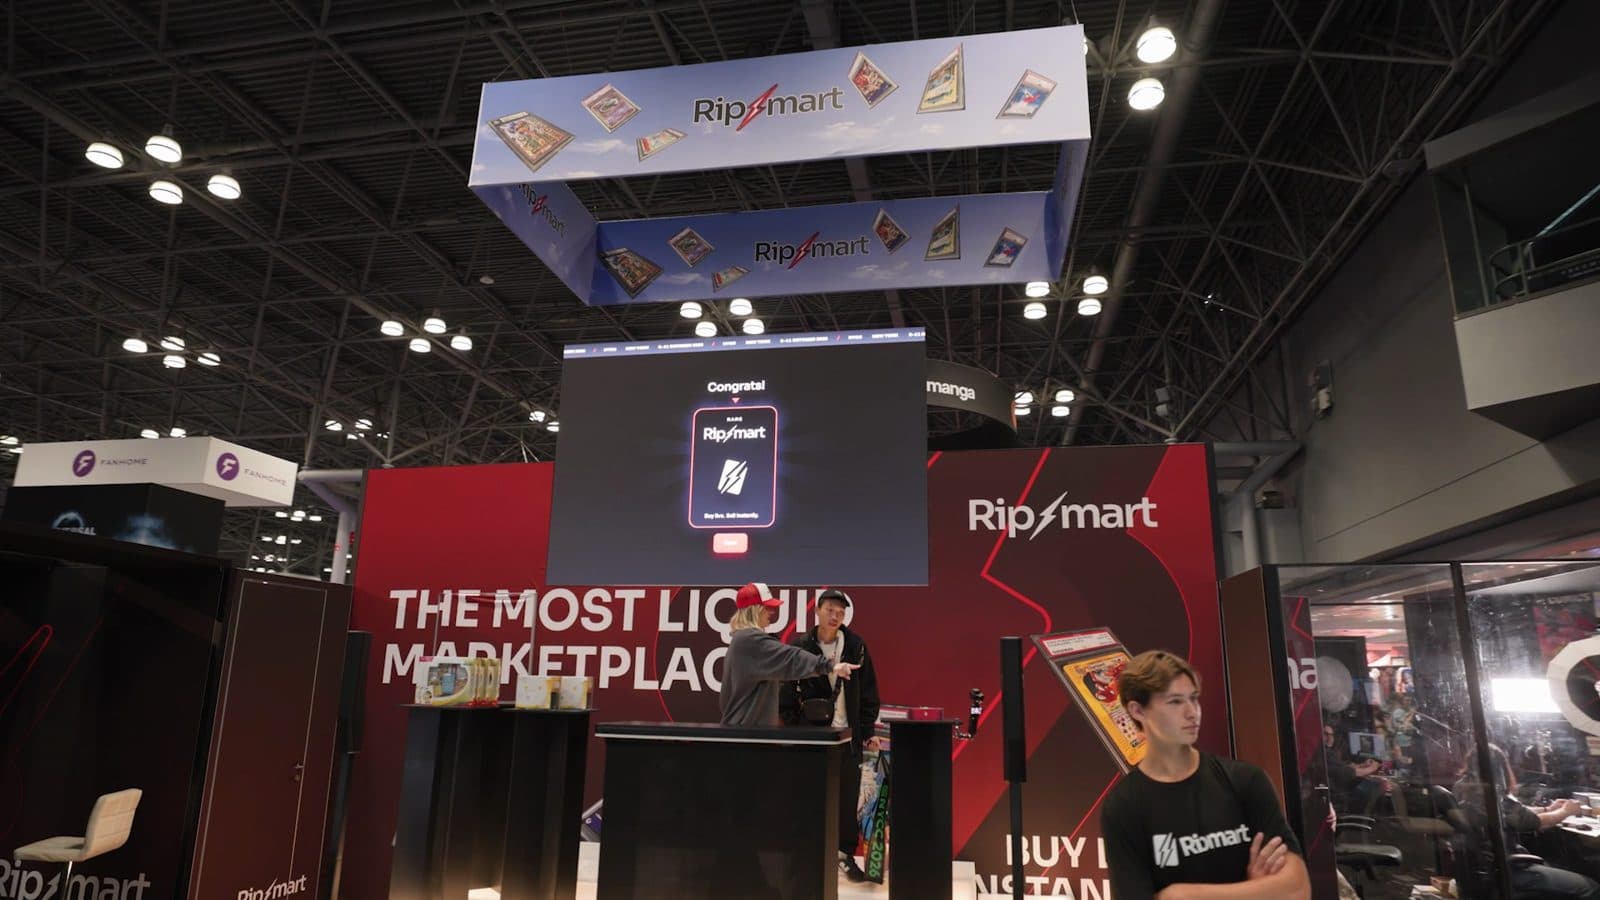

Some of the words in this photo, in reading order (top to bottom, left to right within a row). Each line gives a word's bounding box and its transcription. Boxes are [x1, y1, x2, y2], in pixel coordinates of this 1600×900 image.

[707, 380, 766, 393] Congrats!
[100, 457, 149, 466] FANHOME
[243, 468, 288, 486] FANHOME
[389, 589, 480, 630] THE
[492, 588, 645, 632] MOST
